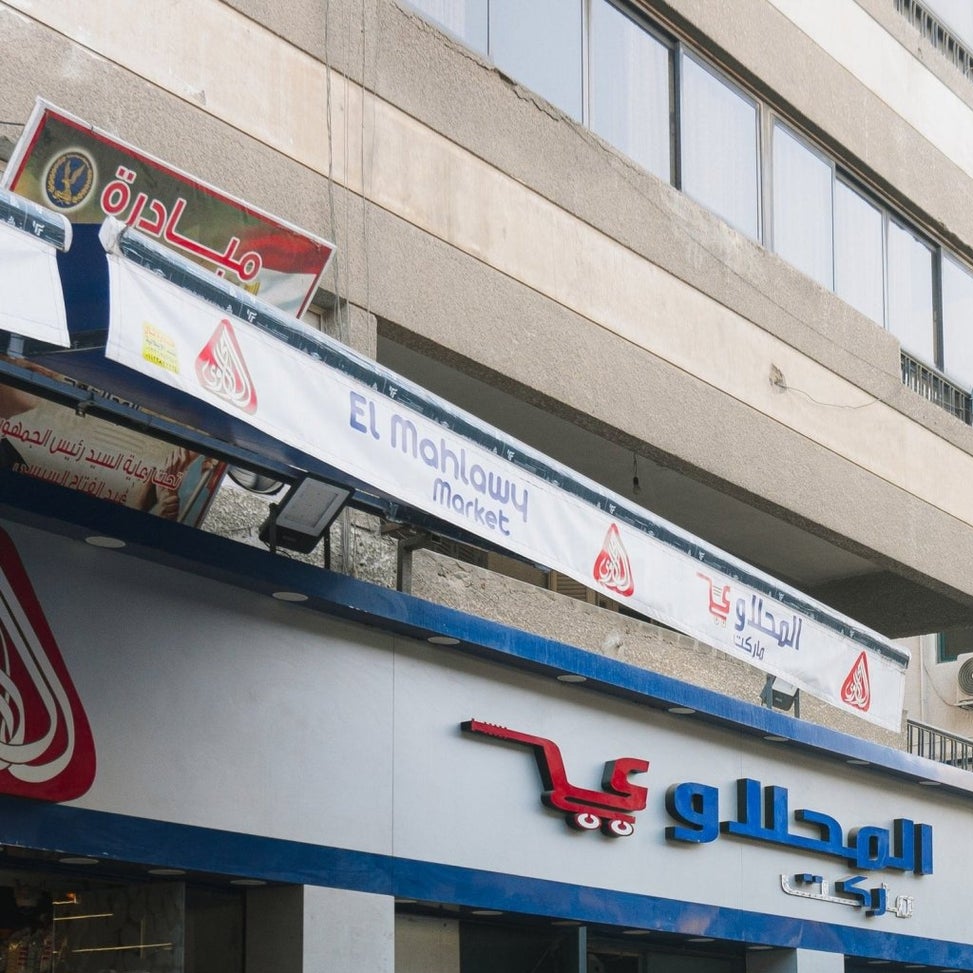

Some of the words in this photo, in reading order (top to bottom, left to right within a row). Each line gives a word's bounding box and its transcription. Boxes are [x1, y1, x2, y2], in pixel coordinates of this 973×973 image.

[101, 165, 262, 281] مبادرة
[50, 438, 86, 461] رئيس
[86, 448, 123, 469] السيد
[349, 390, 380, 440] El
[390, 413, 528, 523] Mahlawy
[432, 476, 511, 537] Market
[733, 634, 765, 661] ماركت
[460, 716, 934, 876] المحلاوي
[779, 873, 915, 919] ماركت
